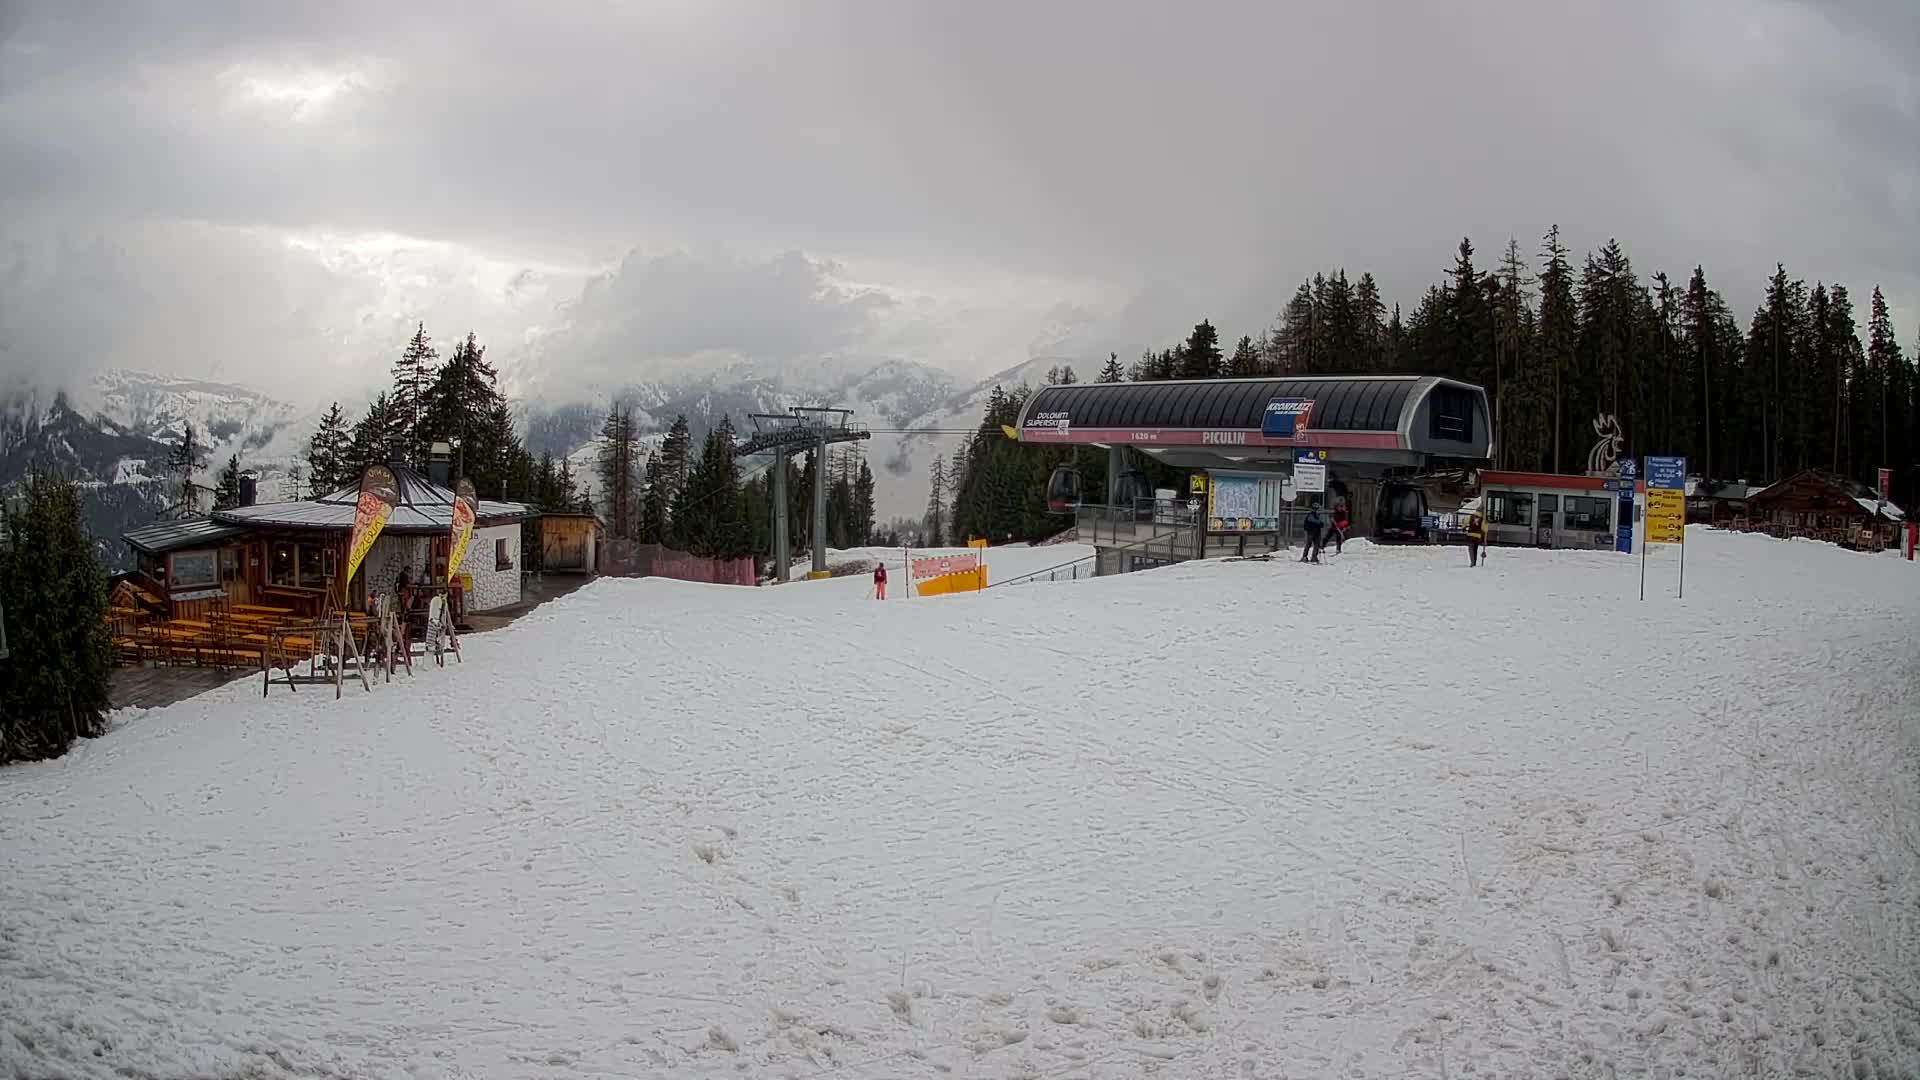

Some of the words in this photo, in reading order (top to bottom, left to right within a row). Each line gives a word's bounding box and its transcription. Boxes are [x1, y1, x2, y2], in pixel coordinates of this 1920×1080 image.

[1266, 402, 1313, 411] KRONPLATZ
[1026, 419, 1059, 427] SUPERSKI
[1131, 432, 1149, 440] 1620
[1202, 431, 1247, 444] PICULIN
[349, 520, 383, 568] PIZZERIA
